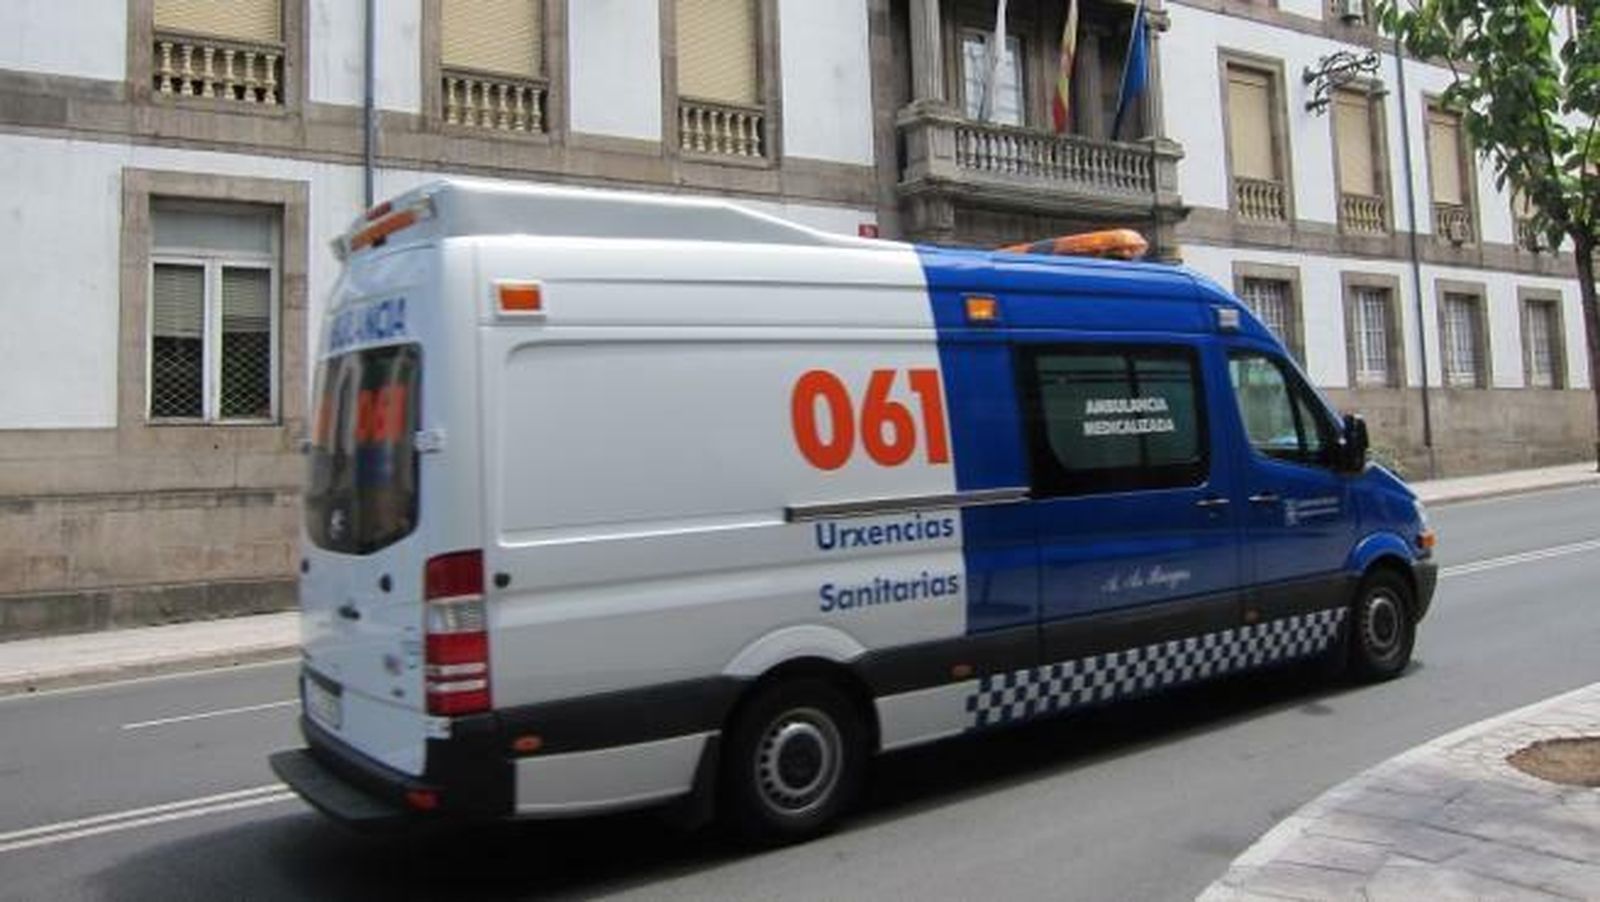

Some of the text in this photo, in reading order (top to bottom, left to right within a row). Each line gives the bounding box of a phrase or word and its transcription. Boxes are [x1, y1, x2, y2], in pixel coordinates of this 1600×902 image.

[791, 369, 950, 471] 061
[815, 511, 955, 550] Urxencias
[819, 571, 960, 612] Sanitarias
